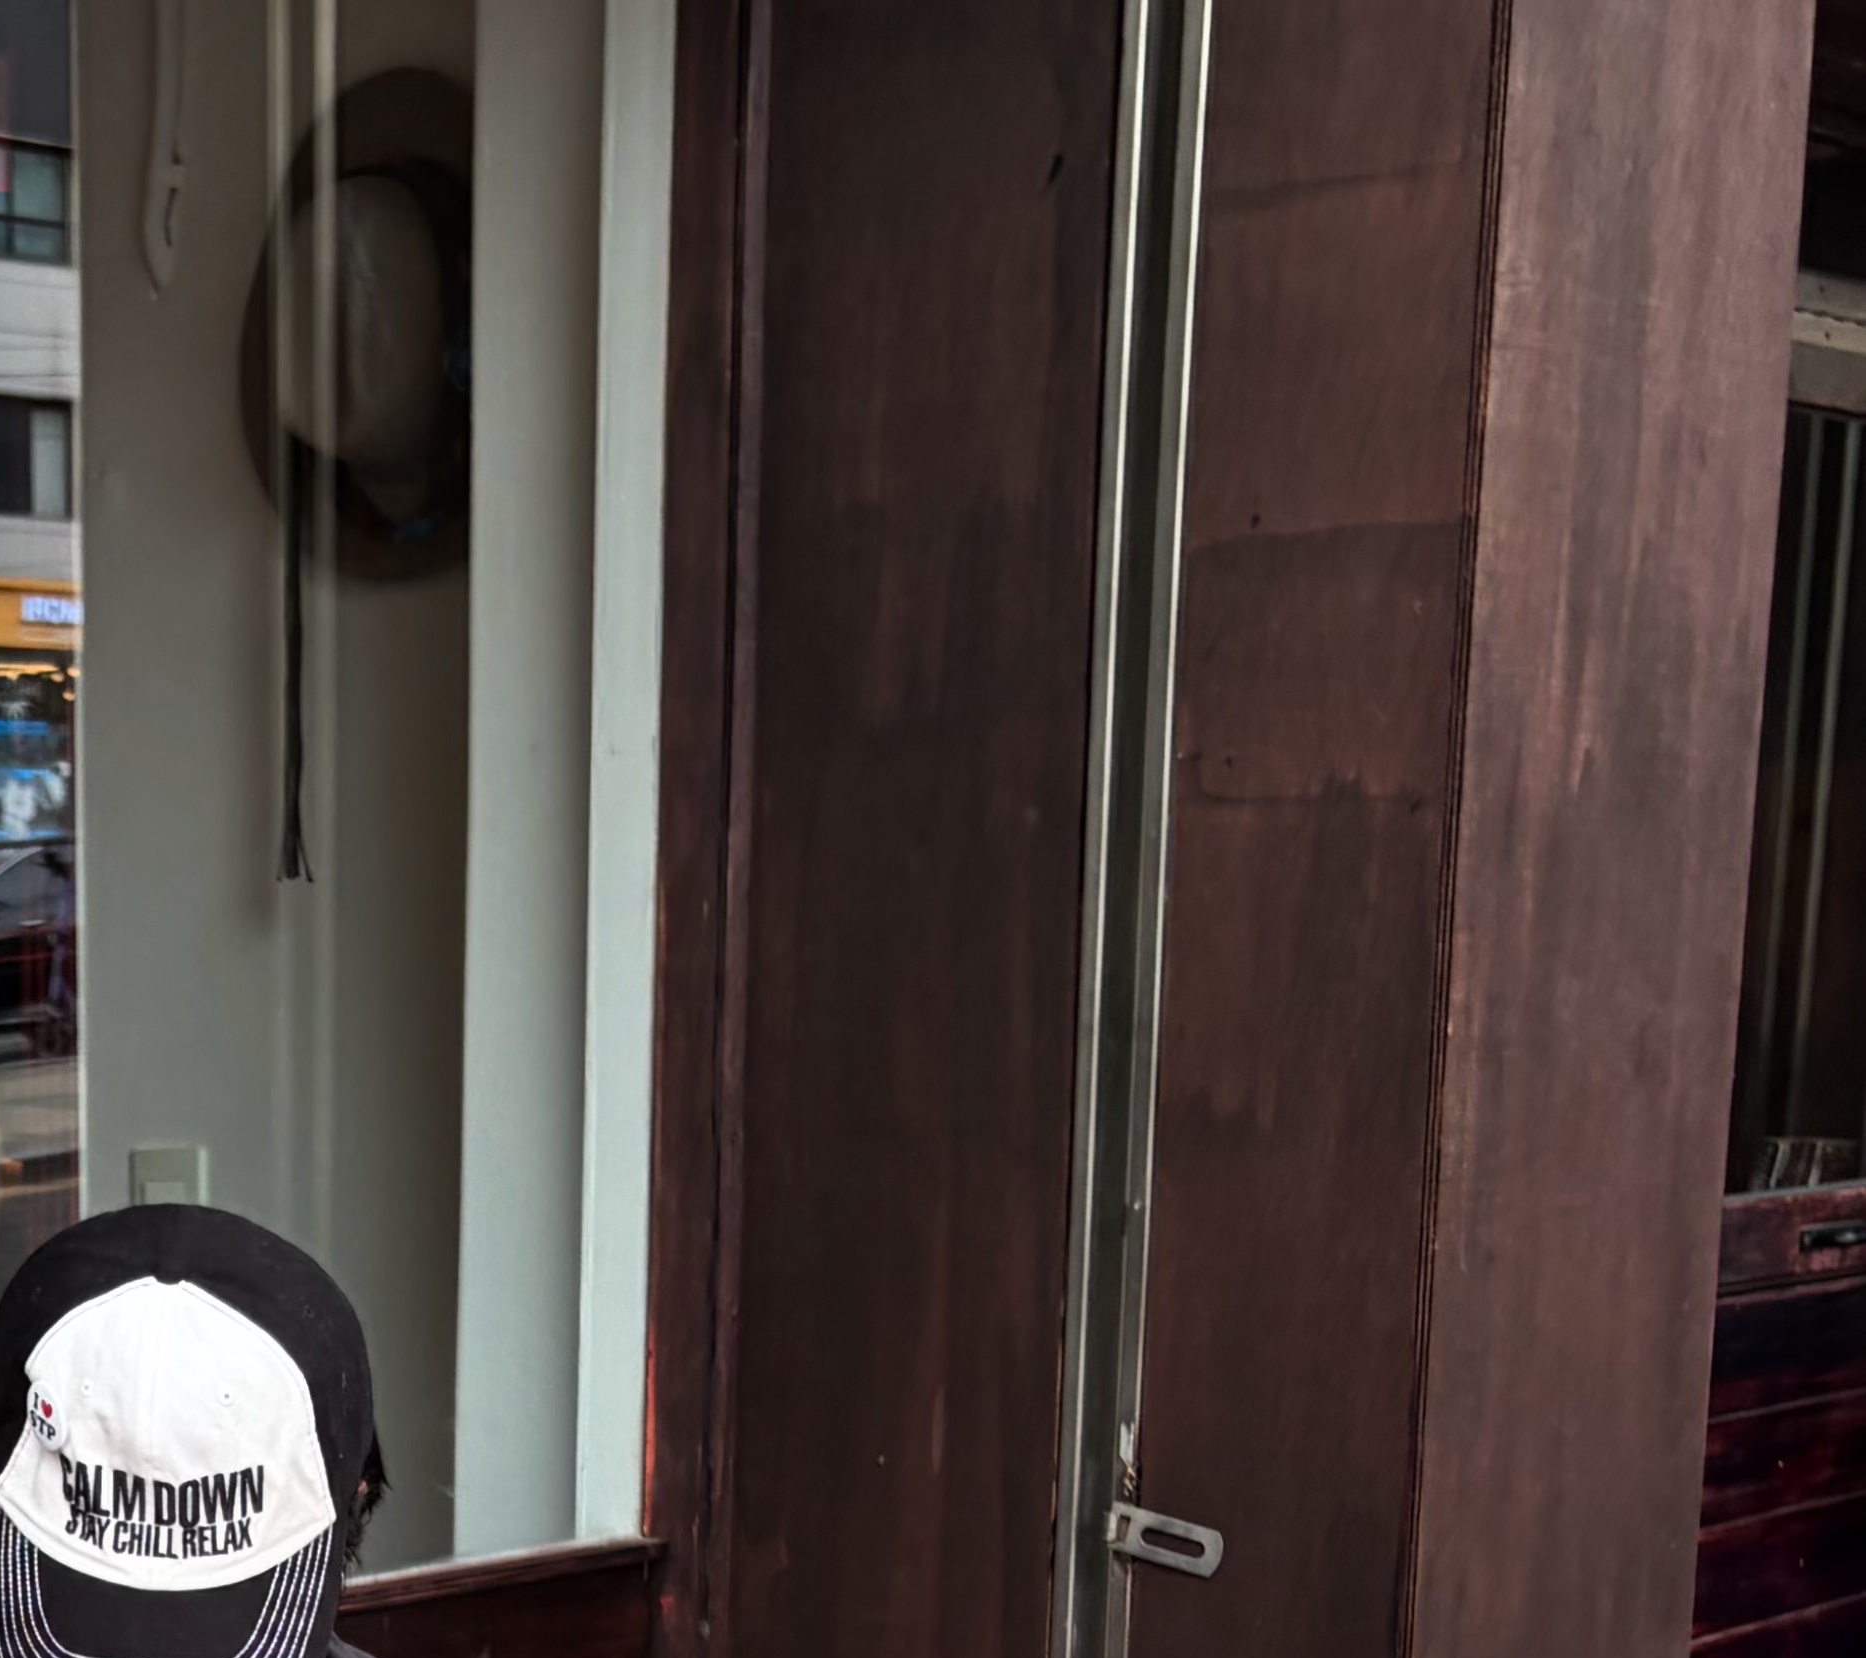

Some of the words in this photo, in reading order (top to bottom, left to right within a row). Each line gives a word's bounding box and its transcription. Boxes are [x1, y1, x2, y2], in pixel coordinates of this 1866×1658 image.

[30, 1410, 56, 1440] STP
[59, 1452, 146, 1522] CALM
[153, 1465, 264, 1528] DOWN
[65, 1504, 111, 1549] STAY
[112, 1520, 179, 1559] CHILL
[182, 1517, 253, 1559] RELAX
